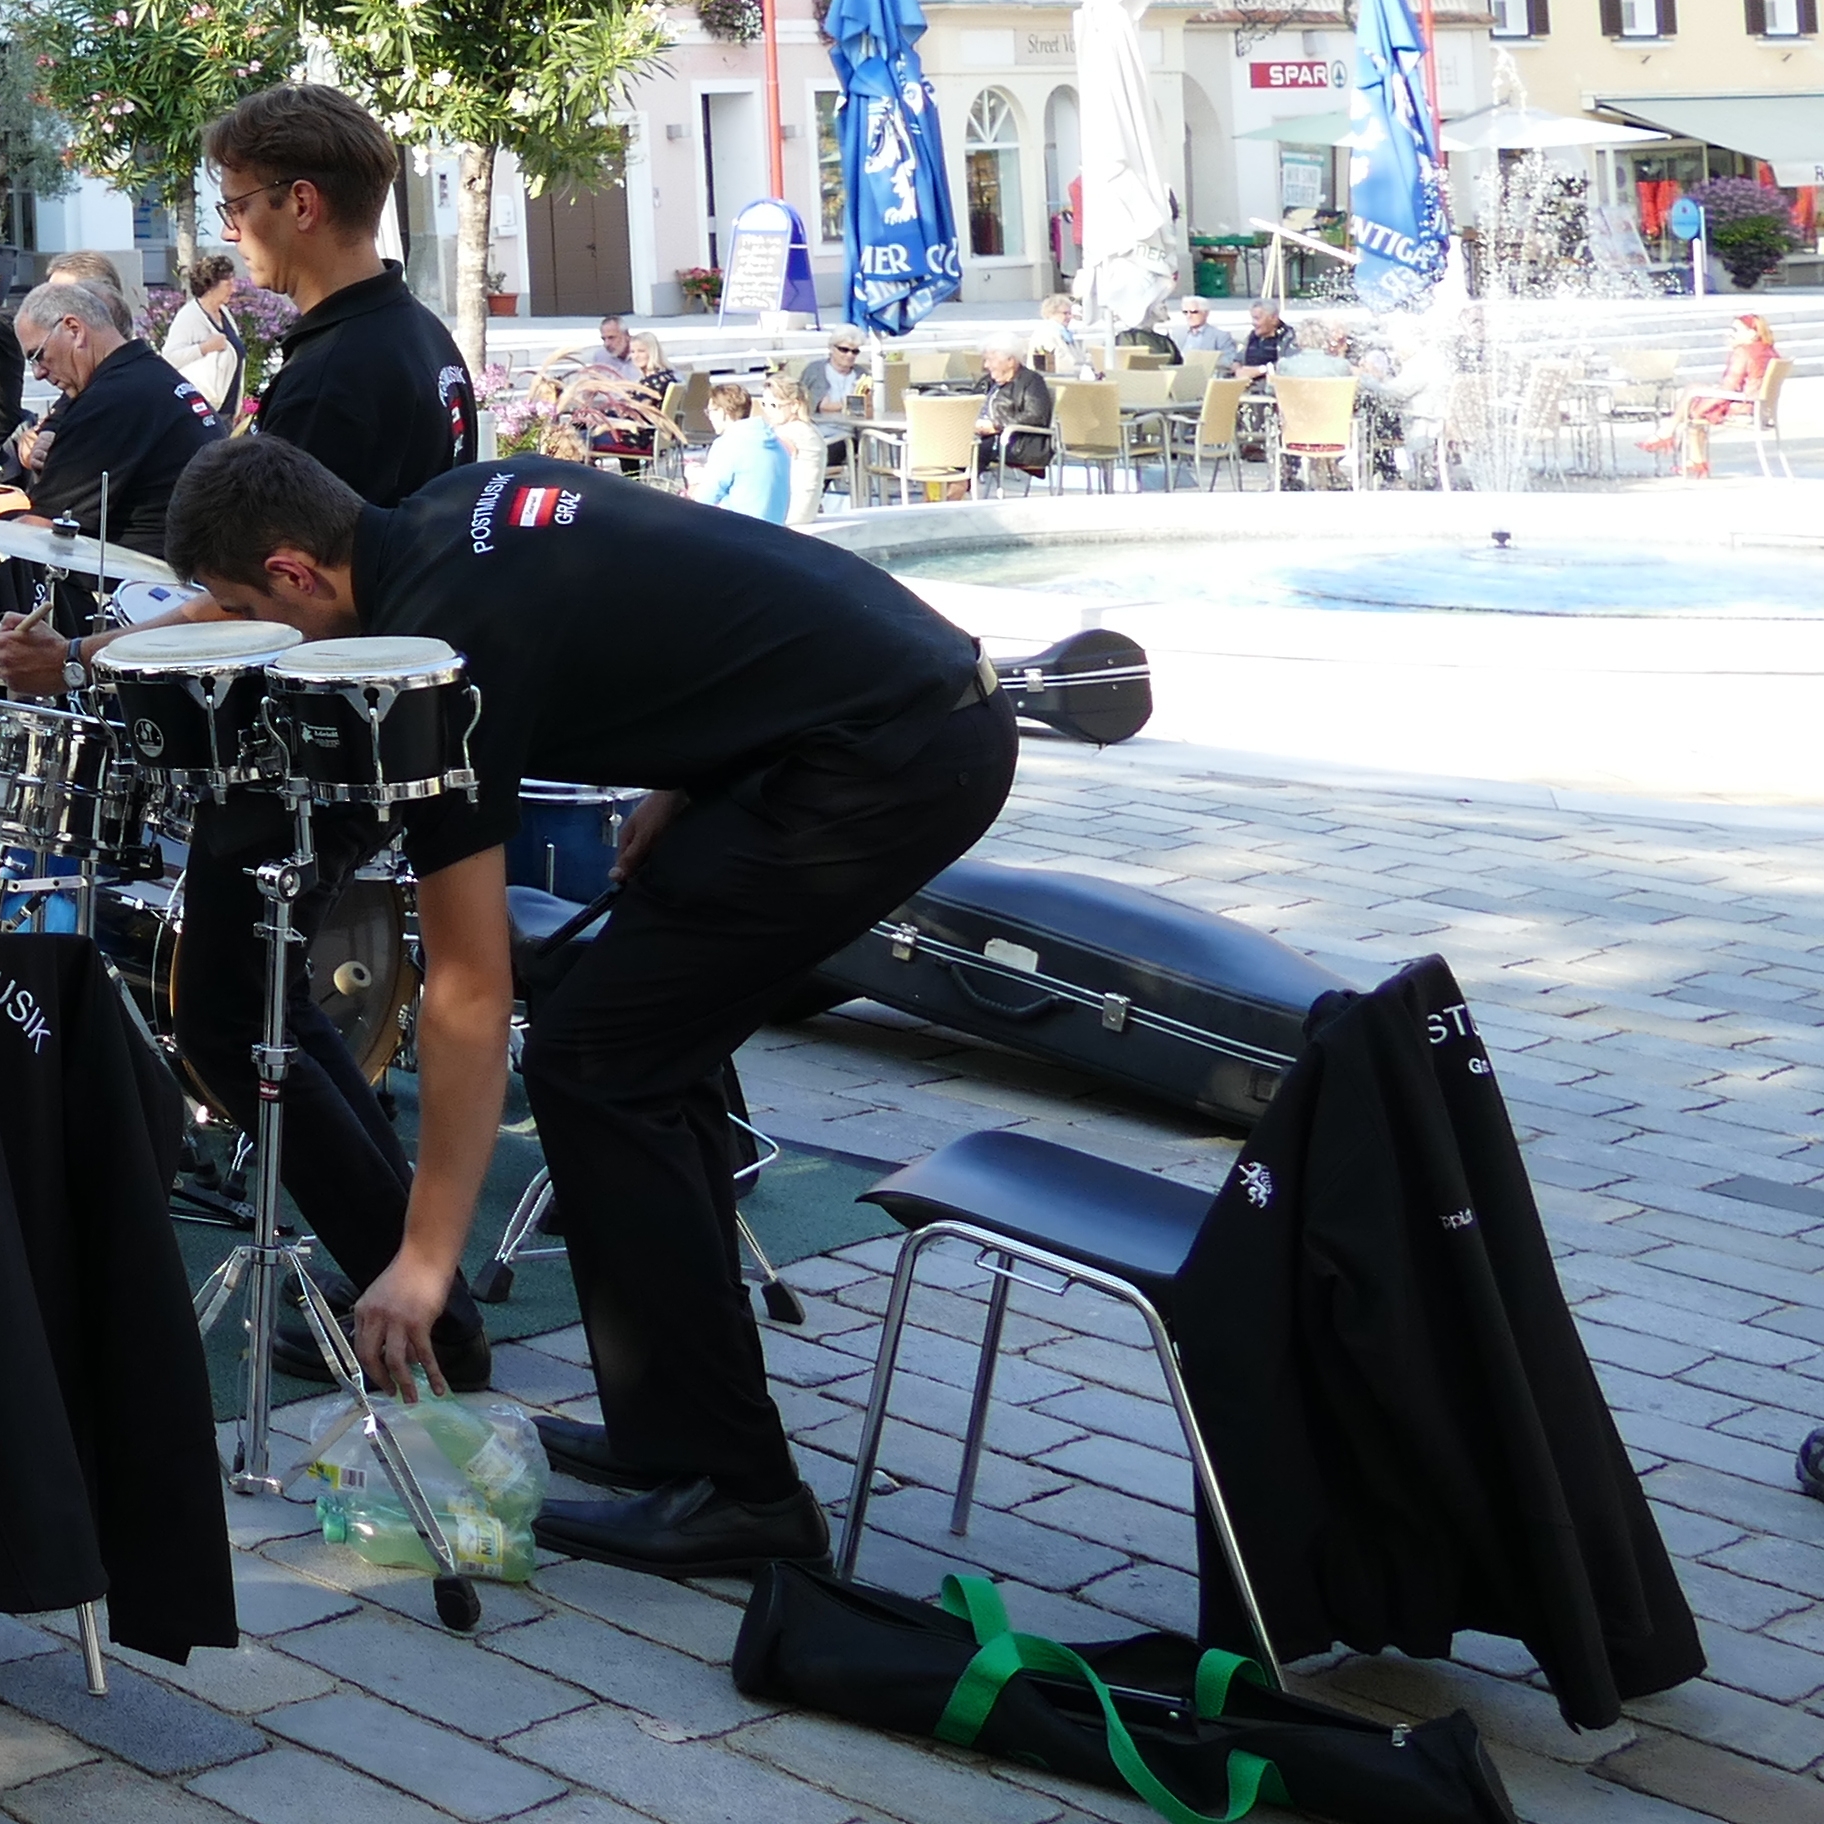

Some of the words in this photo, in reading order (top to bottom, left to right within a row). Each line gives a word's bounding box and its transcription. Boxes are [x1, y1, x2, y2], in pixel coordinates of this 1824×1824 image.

[1028, 34, 1060, 54] Street
[1269, 65, 1328, 86] SPAR
[471, 472, 515, 555] POSTMUSIK
[555, 490, 581, 526] GRAZ
